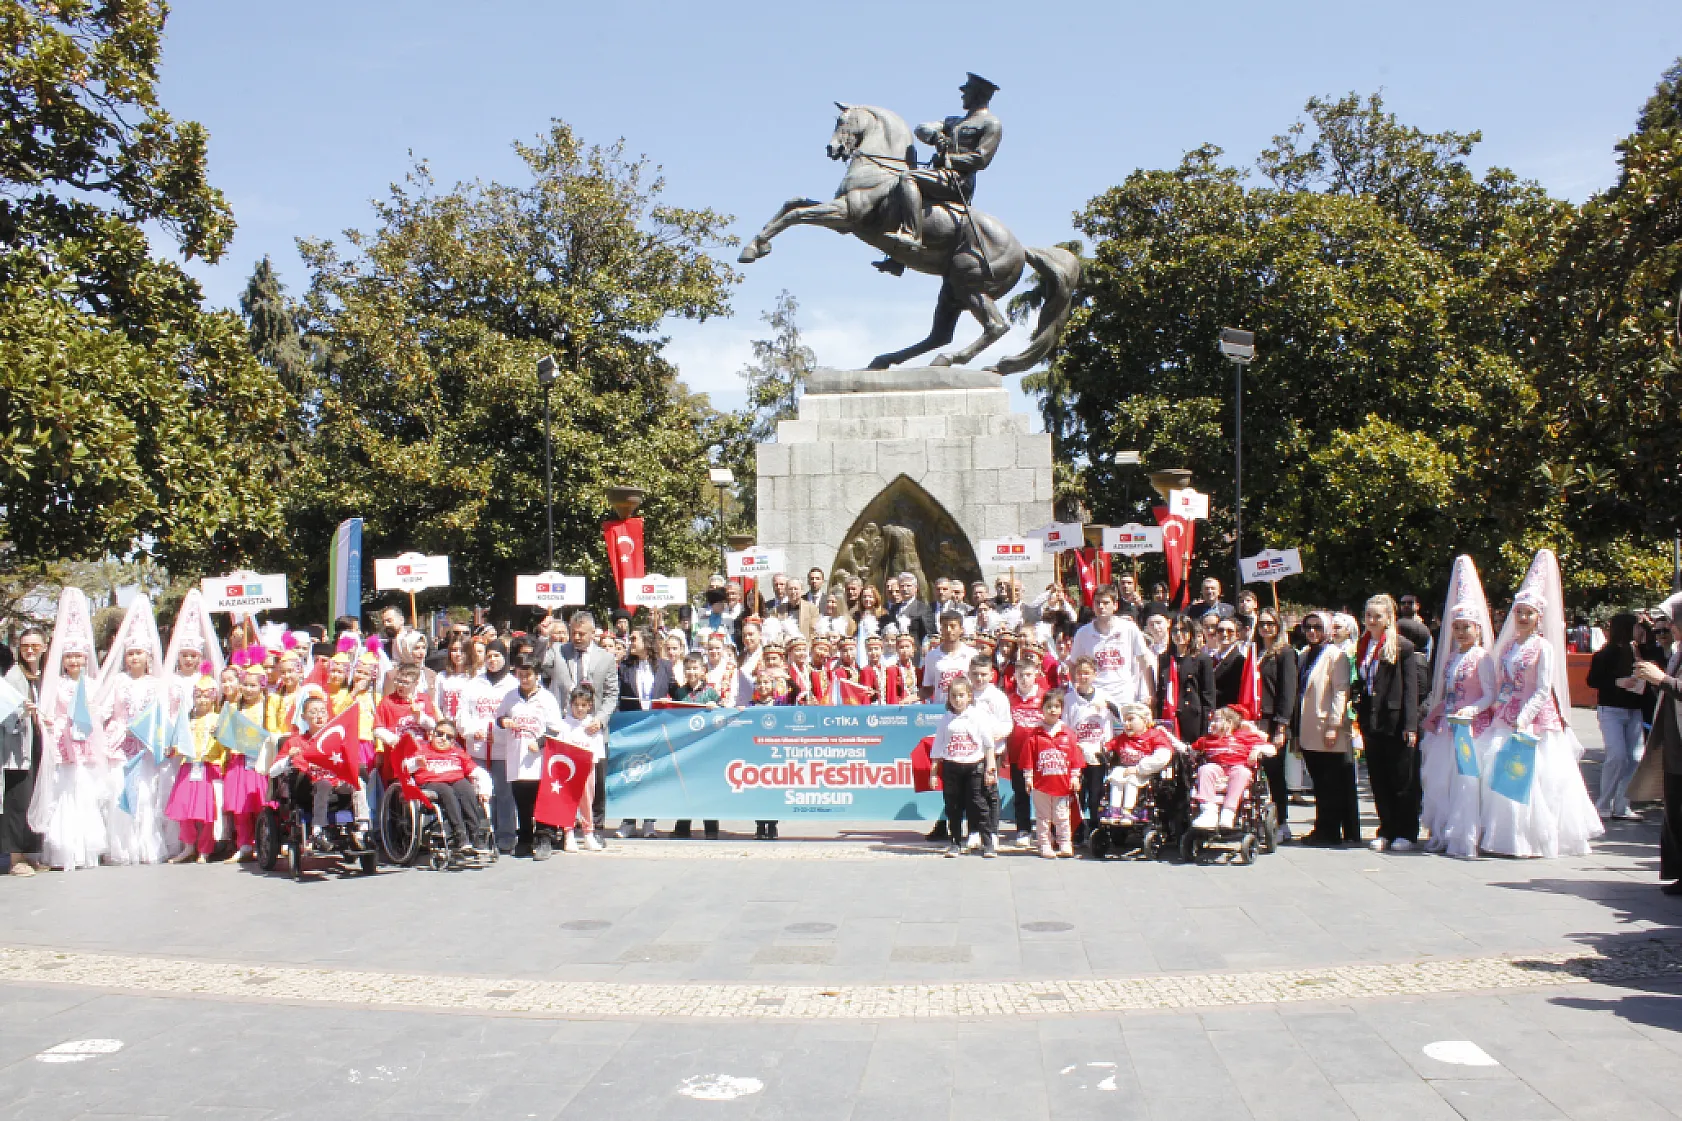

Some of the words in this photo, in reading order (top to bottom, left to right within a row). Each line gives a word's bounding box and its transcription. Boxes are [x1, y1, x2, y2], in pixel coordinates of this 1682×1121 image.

[218, 596, 272, 607] KAZAKİSTAN
[771, 747, 782, 758] 2.
[785, 746, 812, 758] Türk
[813, 746, 866, 759] Dünyası
[726, 761, 805, 791] Çocuk
[809, 760, 912, 787] Festivali
[784, 789, 853, 804] Samsun
